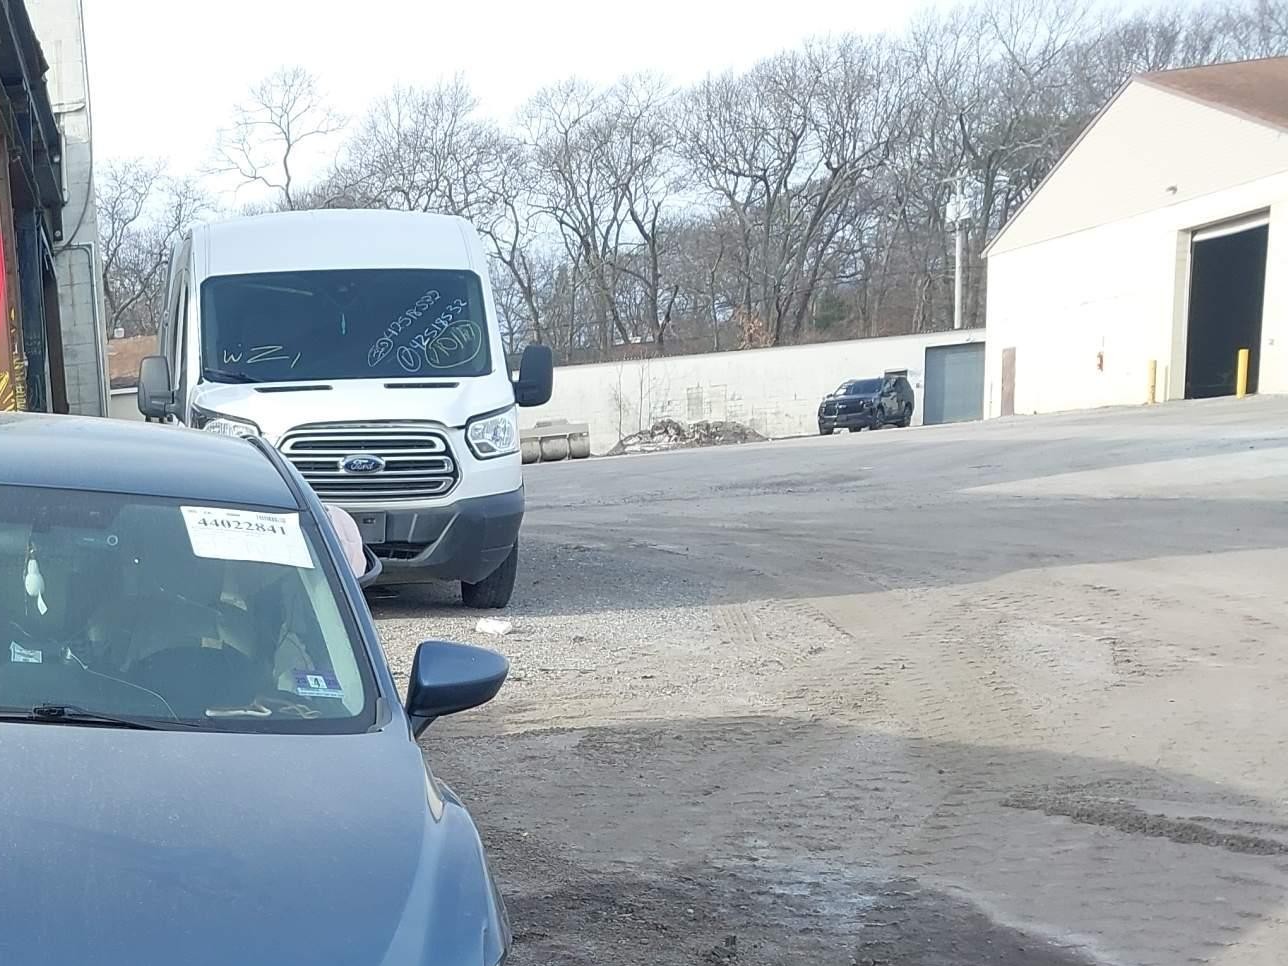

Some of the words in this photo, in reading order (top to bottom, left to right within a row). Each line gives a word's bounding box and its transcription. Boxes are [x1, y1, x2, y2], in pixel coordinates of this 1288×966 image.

[409, 298, 467, 352] 42518532
[350, 459, 376, 470] Ford
[198, 517, 287, 536] 44022841
